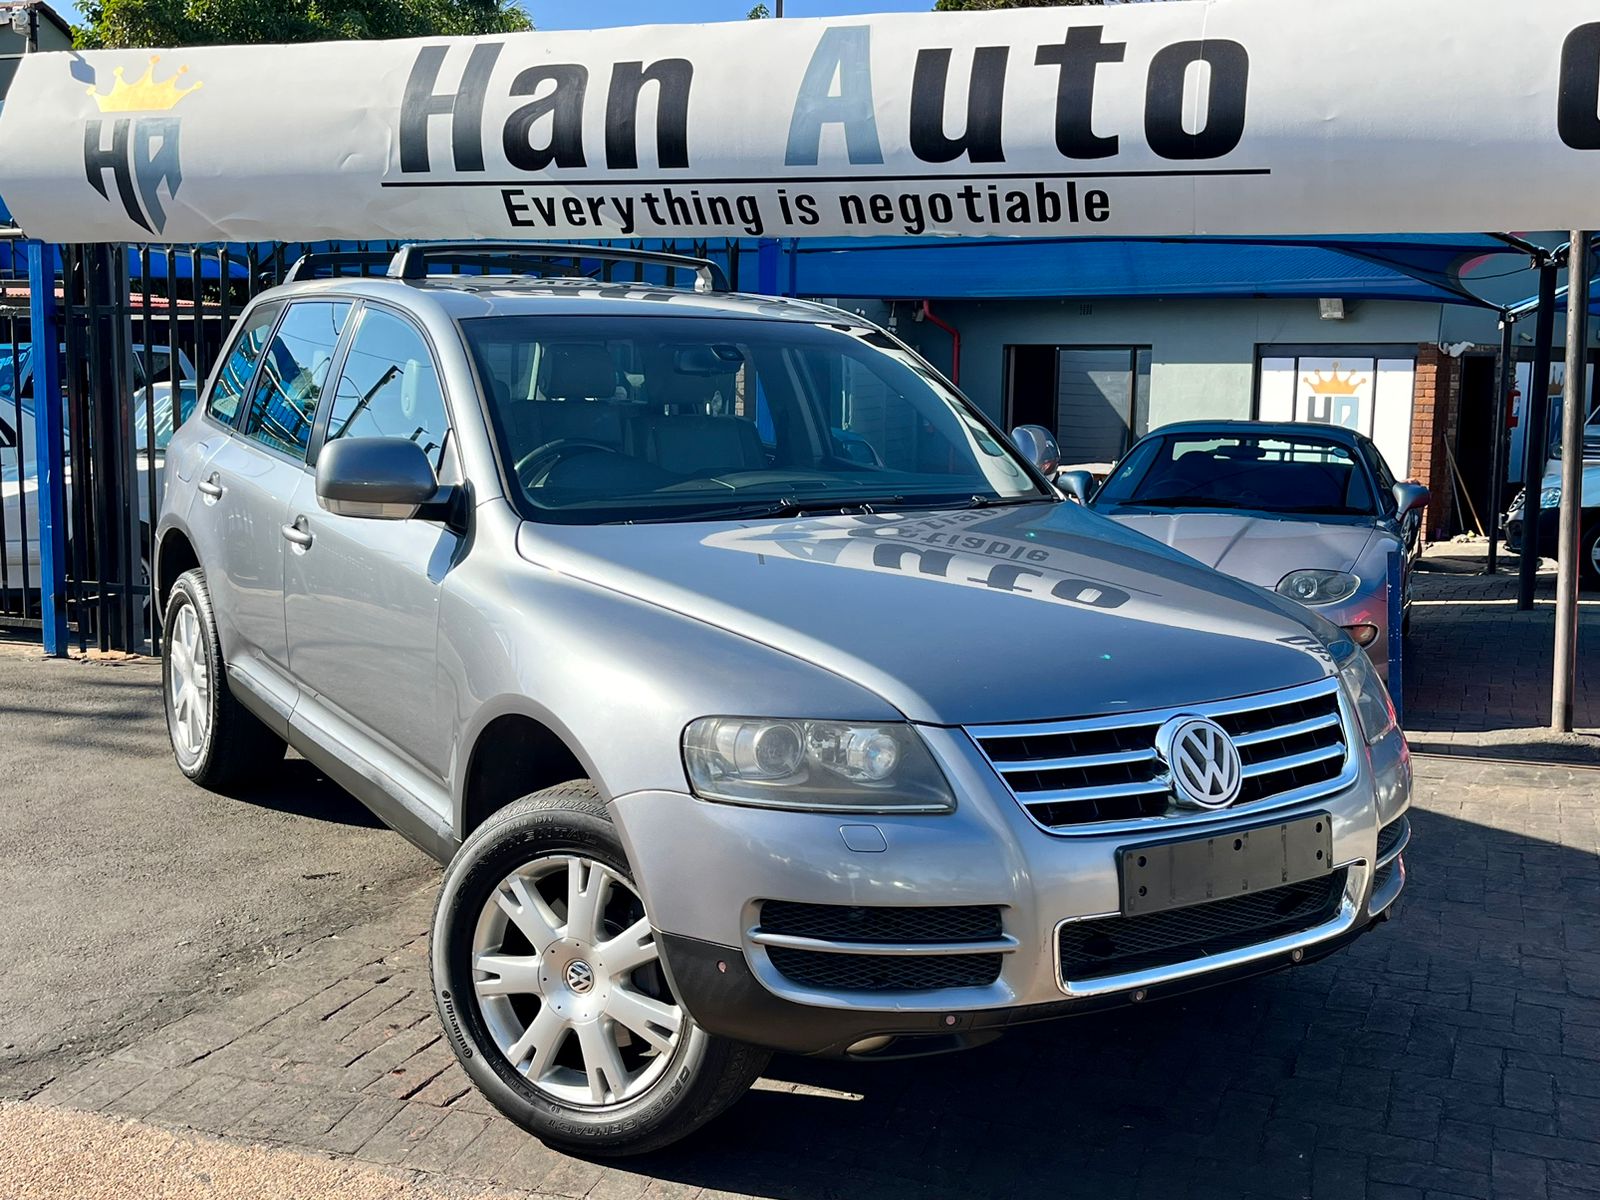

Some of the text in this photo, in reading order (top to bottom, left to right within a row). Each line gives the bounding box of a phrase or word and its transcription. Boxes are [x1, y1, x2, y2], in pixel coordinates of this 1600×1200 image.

[400, 25, 1250, 173] Han Auto
[500, 181, 1111, 236] Everything is negotiable
